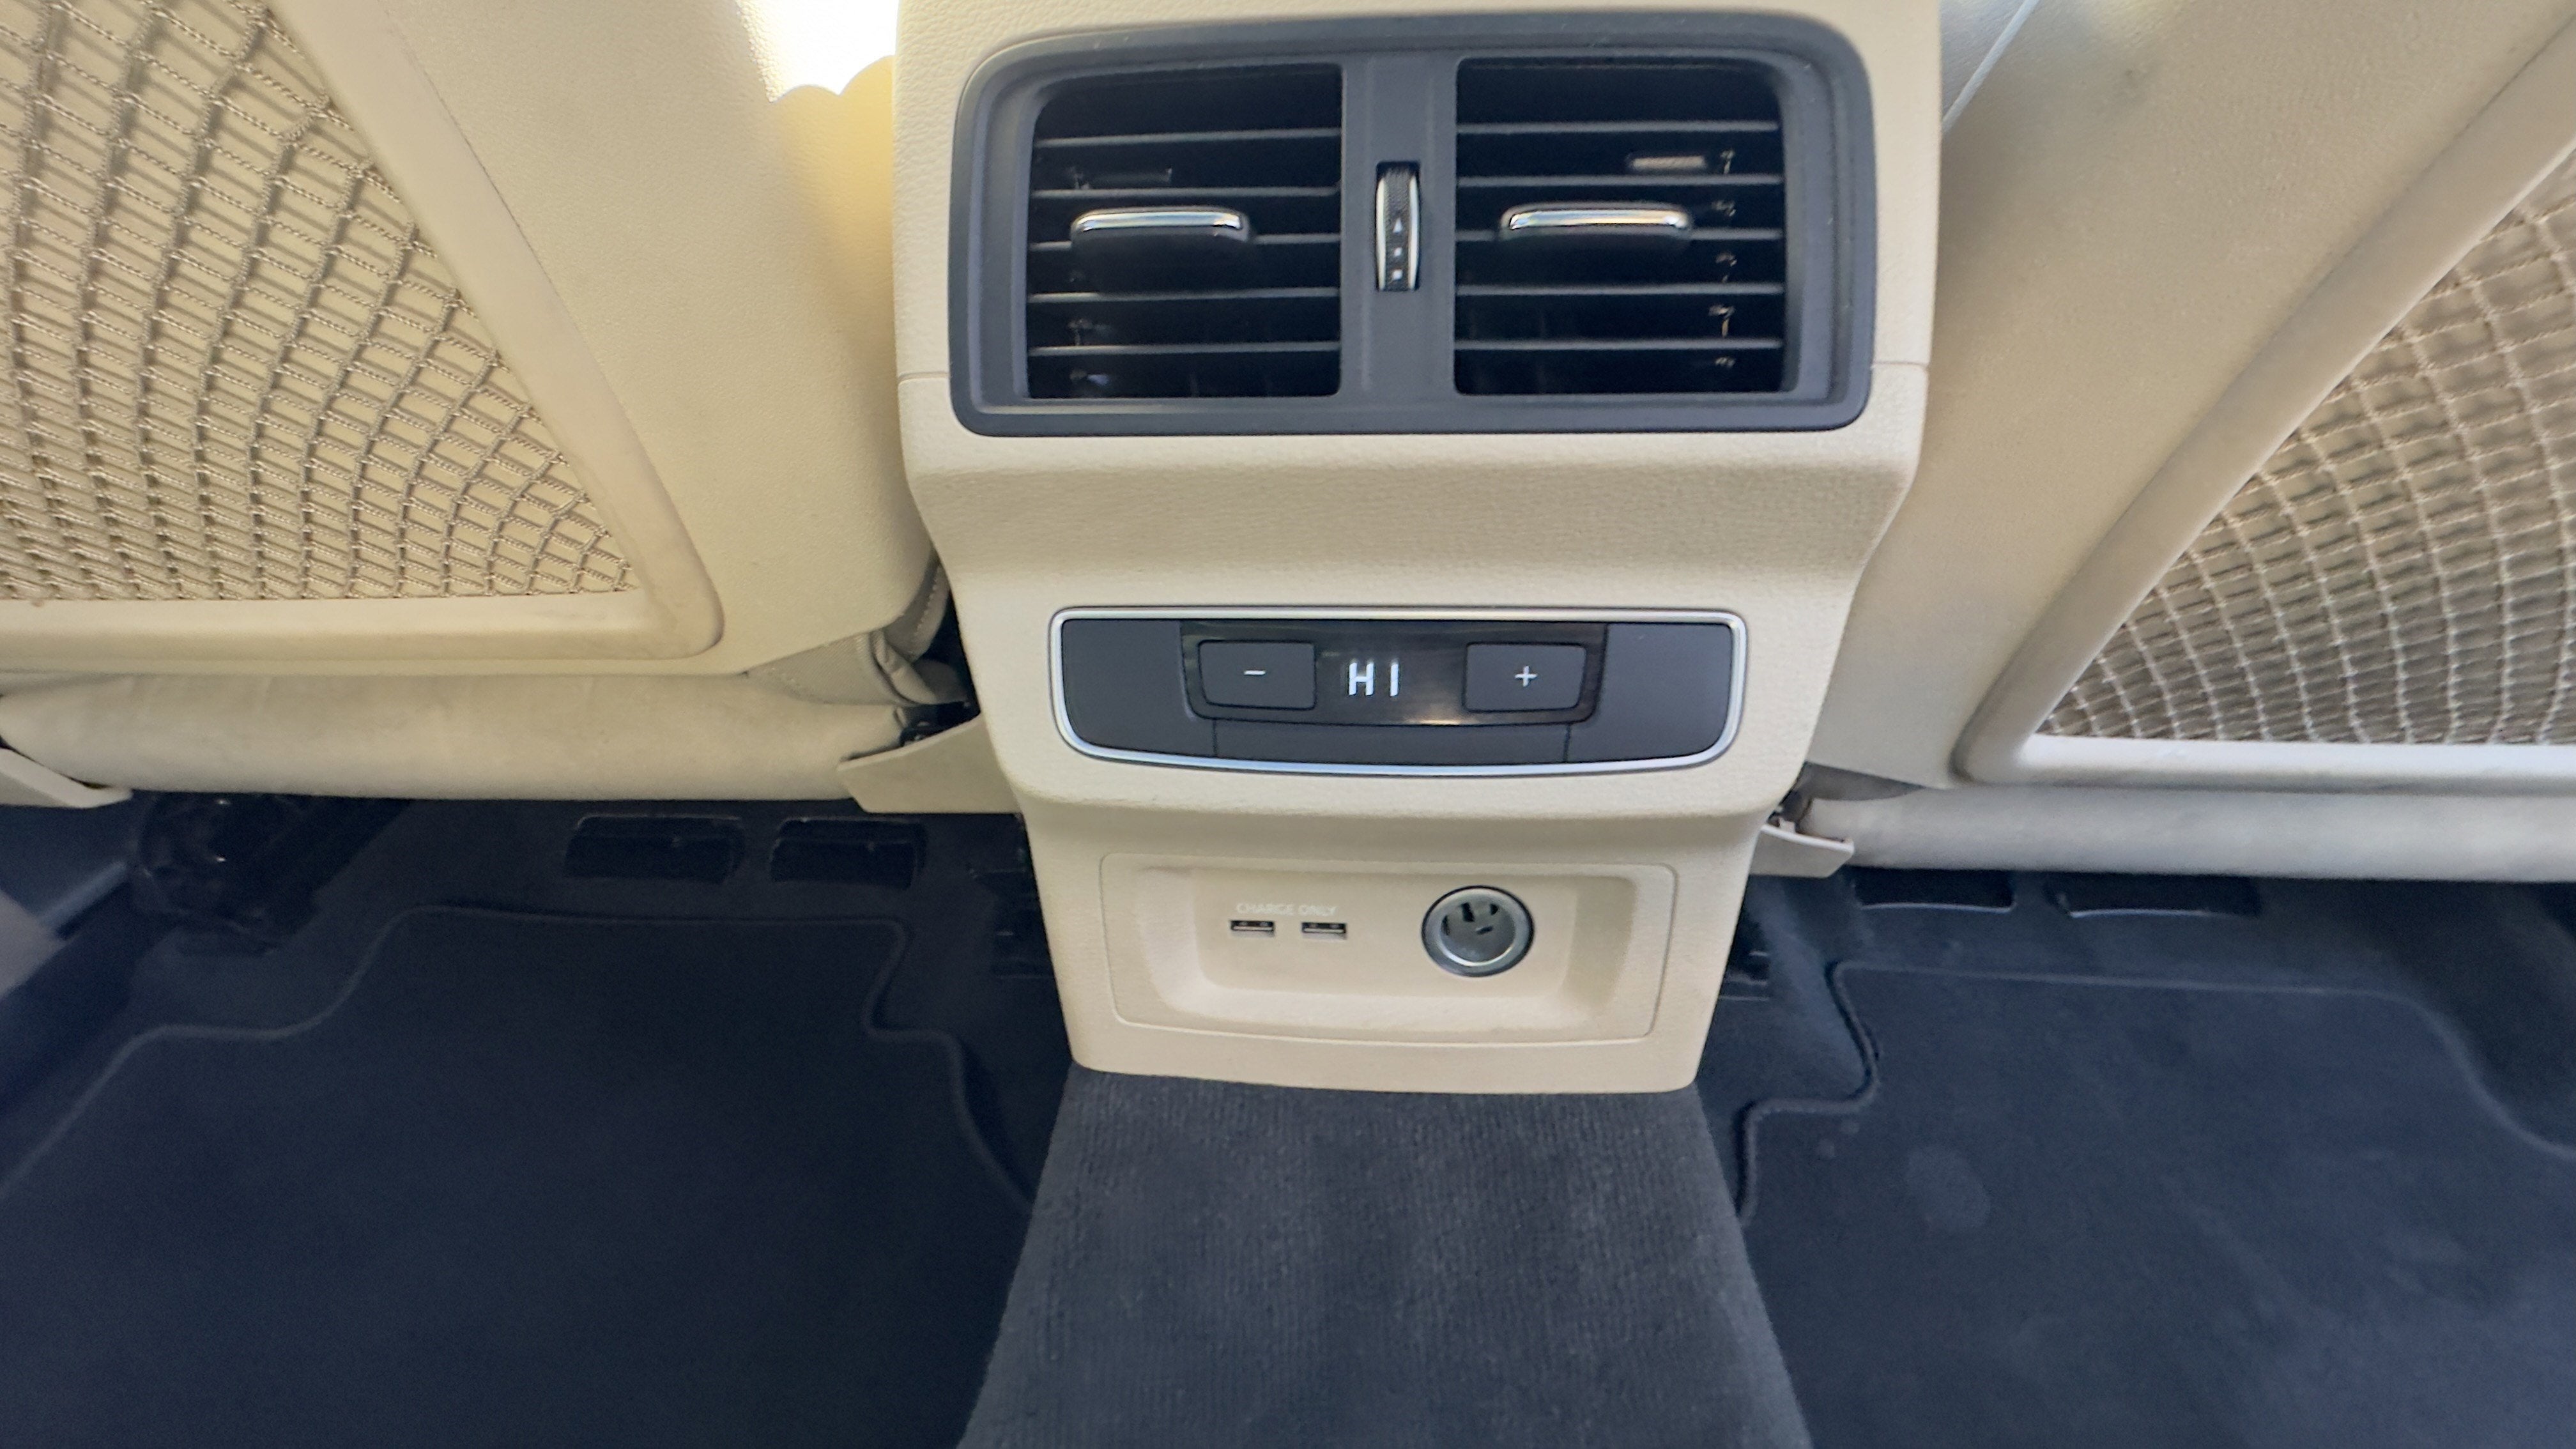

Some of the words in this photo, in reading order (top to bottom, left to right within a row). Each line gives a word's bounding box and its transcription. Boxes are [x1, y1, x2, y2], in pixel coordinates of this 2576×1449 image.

[1348, 661, 1399, 696] HI
[1236, 903, 1294, 916] CHARGE
[1298, 904, 1338, 917] ONLY
